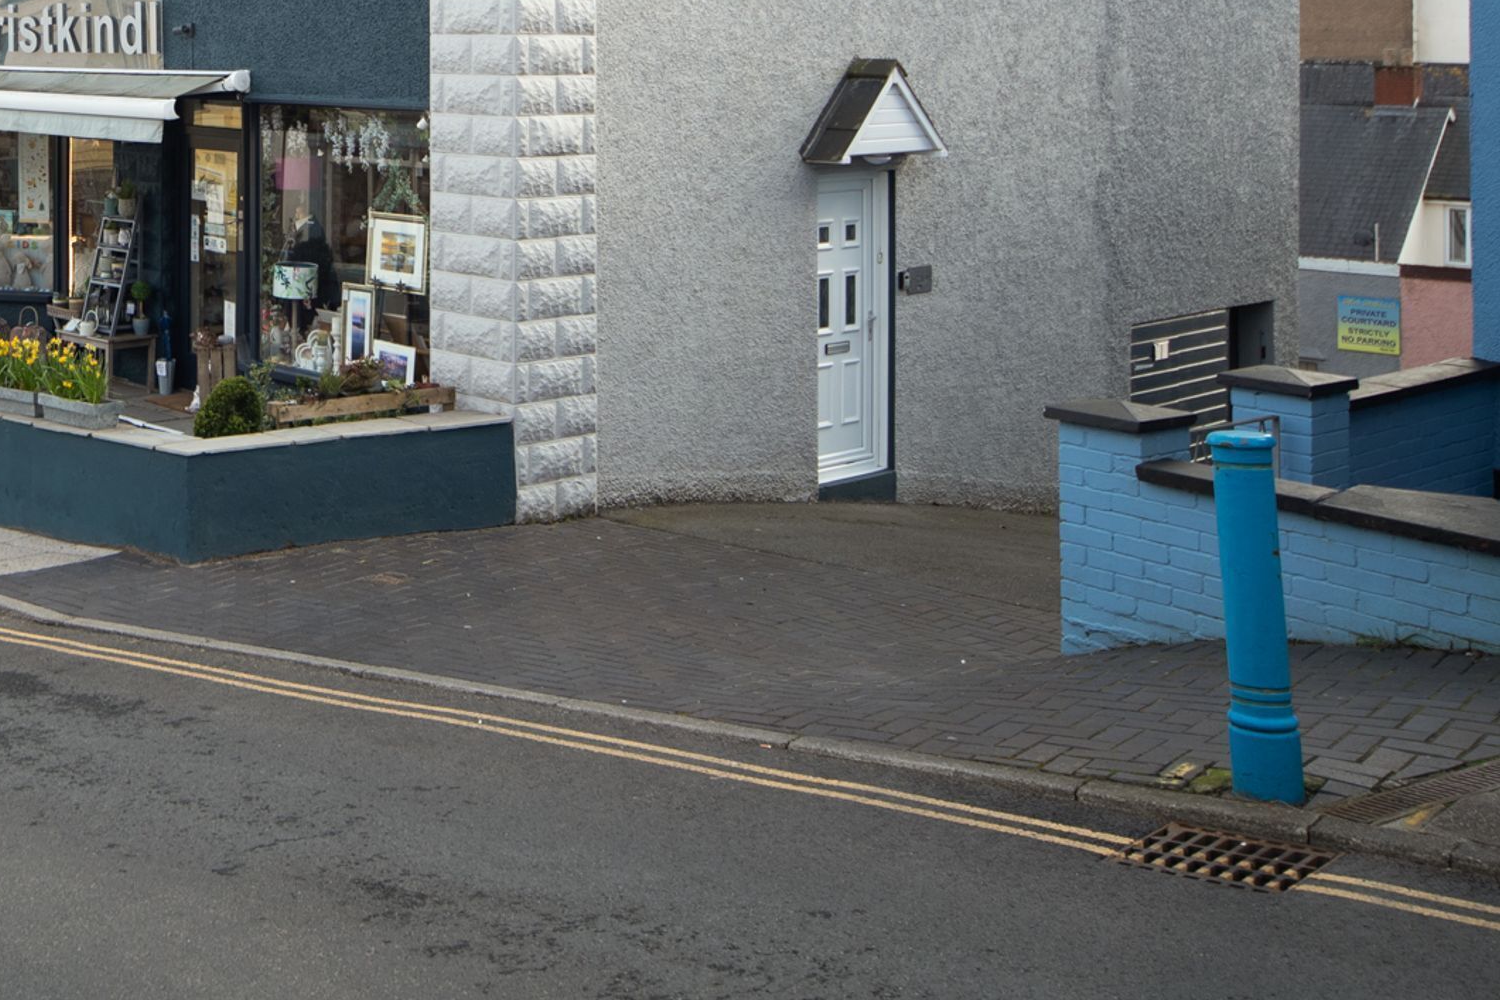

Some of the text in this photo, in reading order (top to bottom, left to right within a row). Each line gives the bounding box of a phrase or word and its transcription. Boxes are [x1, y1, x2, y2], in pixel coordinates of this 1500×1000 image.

[1350, 308, 1387, 318] PRIVATE
[1341, 316, 1396, 328] COURTYARD
[1348, 327, 1390, 338] STRICTLY
[1341, 335, 1396, 348] NO PARKING
